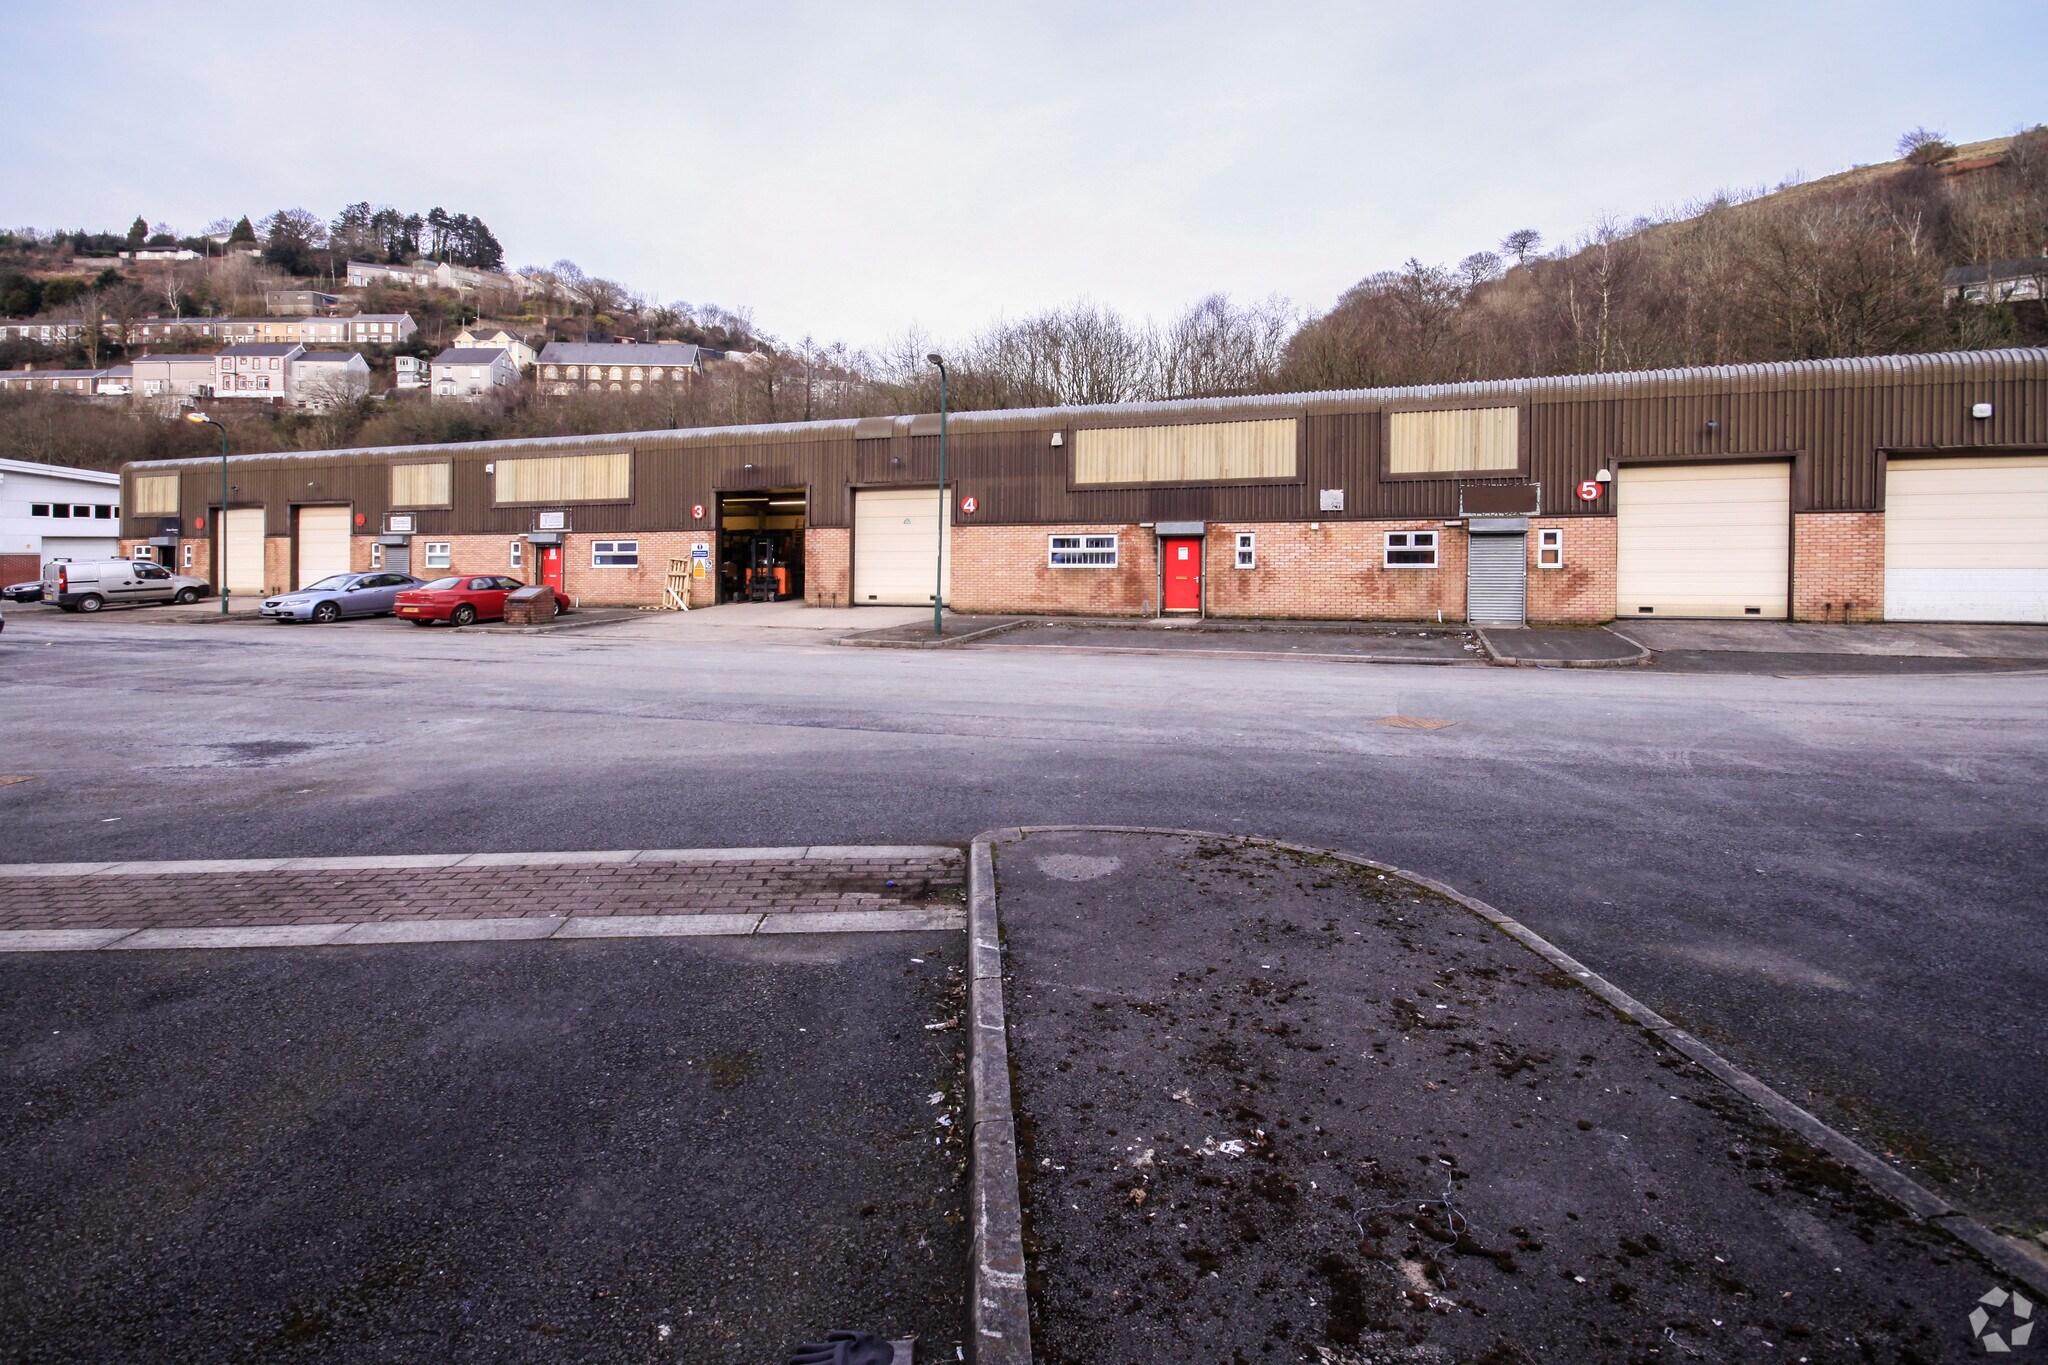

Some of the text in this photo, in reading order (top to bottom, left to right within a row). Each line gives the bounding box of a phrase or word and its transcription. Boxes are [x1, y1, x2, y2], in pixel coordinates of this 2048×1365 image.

[1582, 482, 1597, 499] 5
[694, 505, 703, 518] 3
[963, 498, 975, 512] 4
